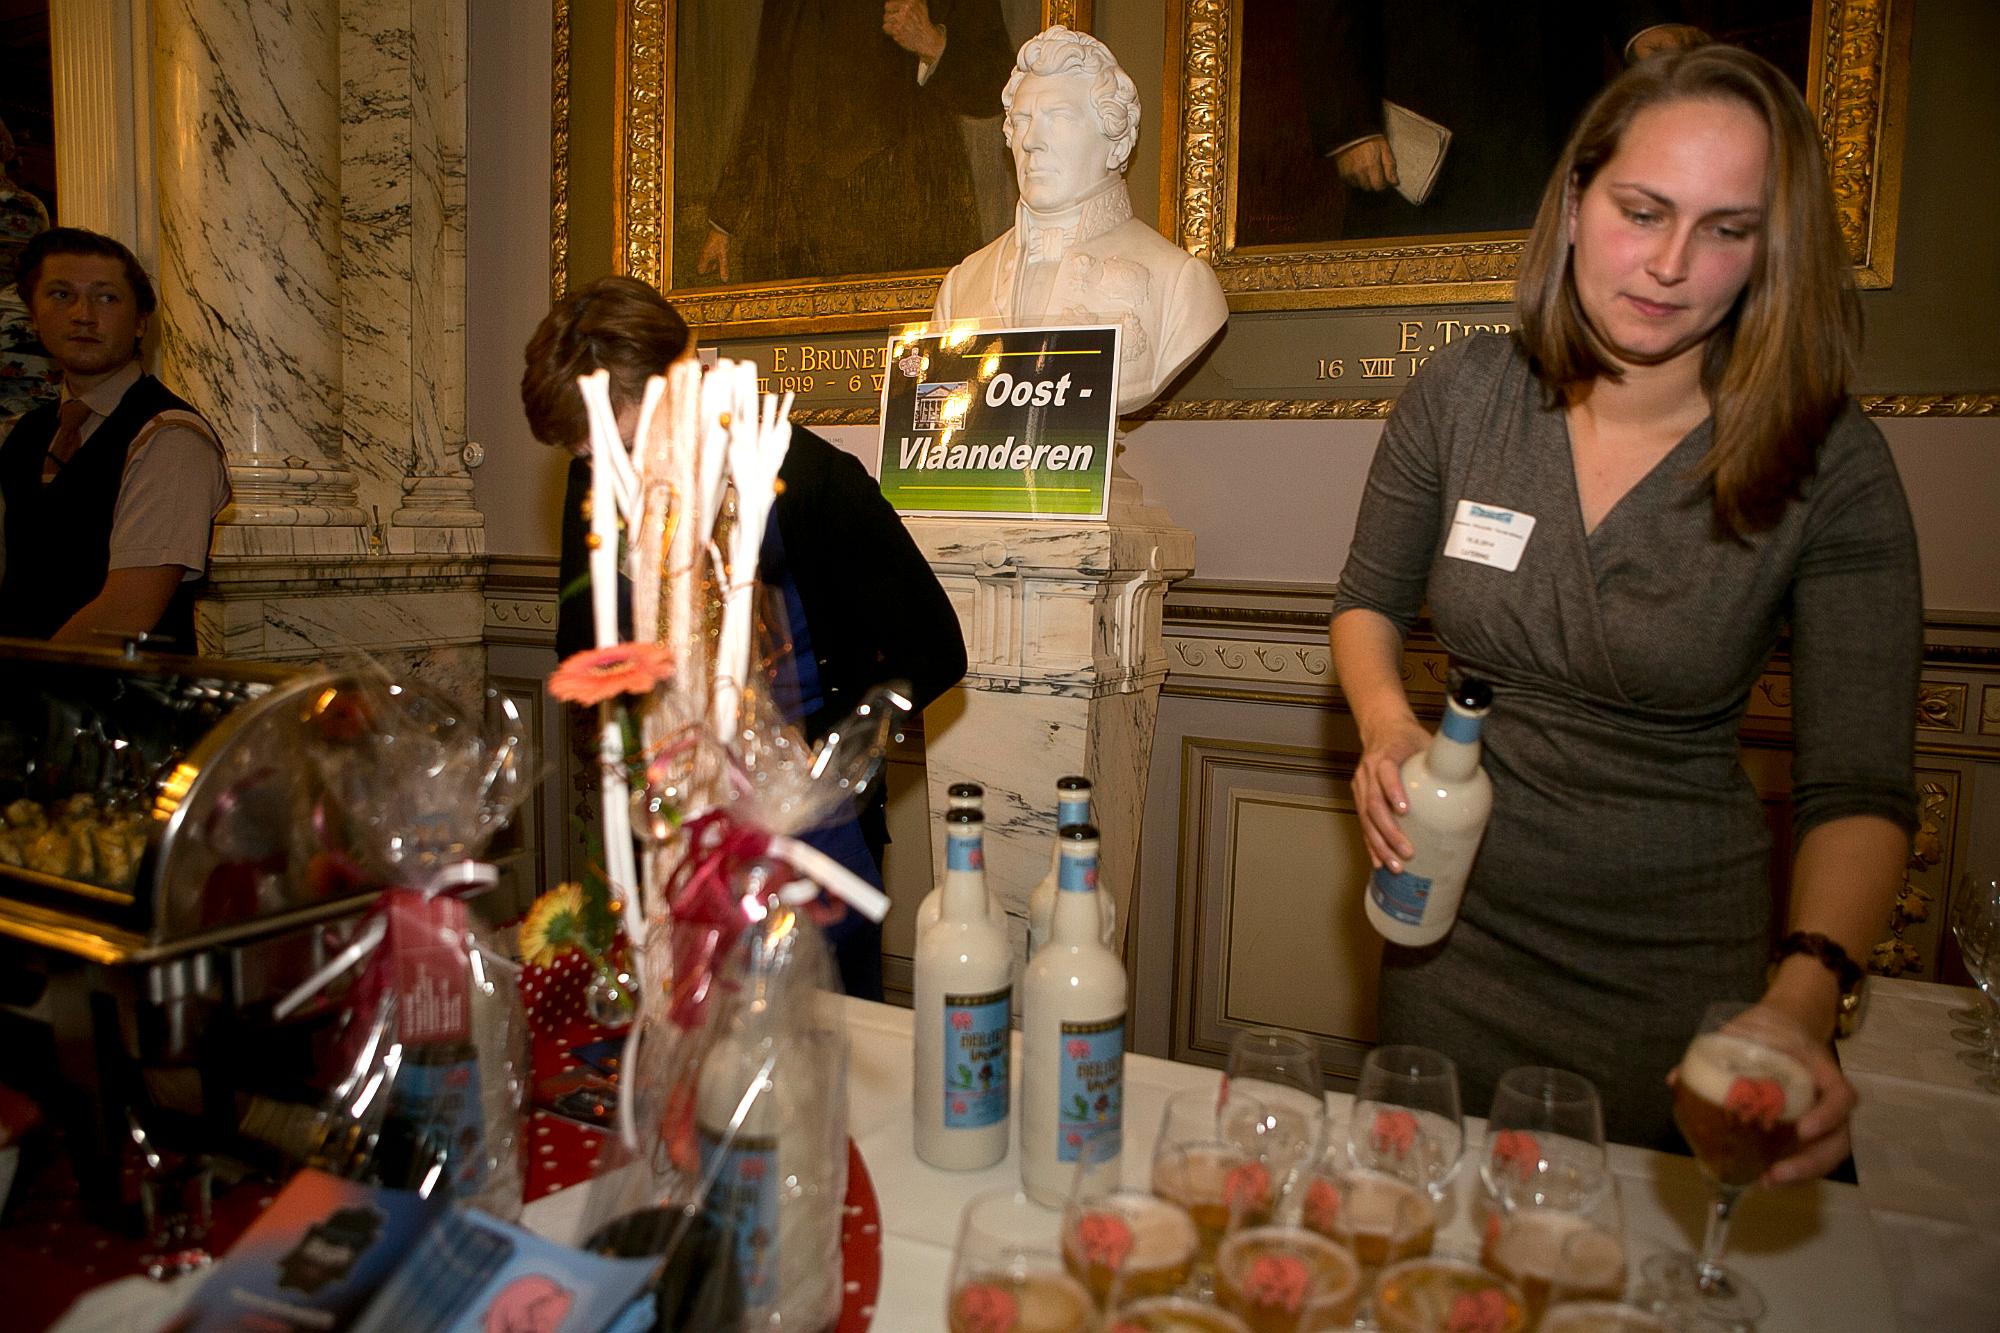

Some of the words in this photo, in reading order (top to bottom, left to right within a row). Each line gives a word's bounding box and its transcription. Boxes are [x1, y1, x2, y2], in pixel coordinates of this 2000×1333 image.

[1318, 359, 1344, 379] 16
[1359, 357, 1397, 378] VIII
[779, 376, 814, 393] 1919
[849, 374, 861, 392] 6
[985, 372, 1071, 408] Oost
[899, 435, 1094, 472] Vlaanderen
